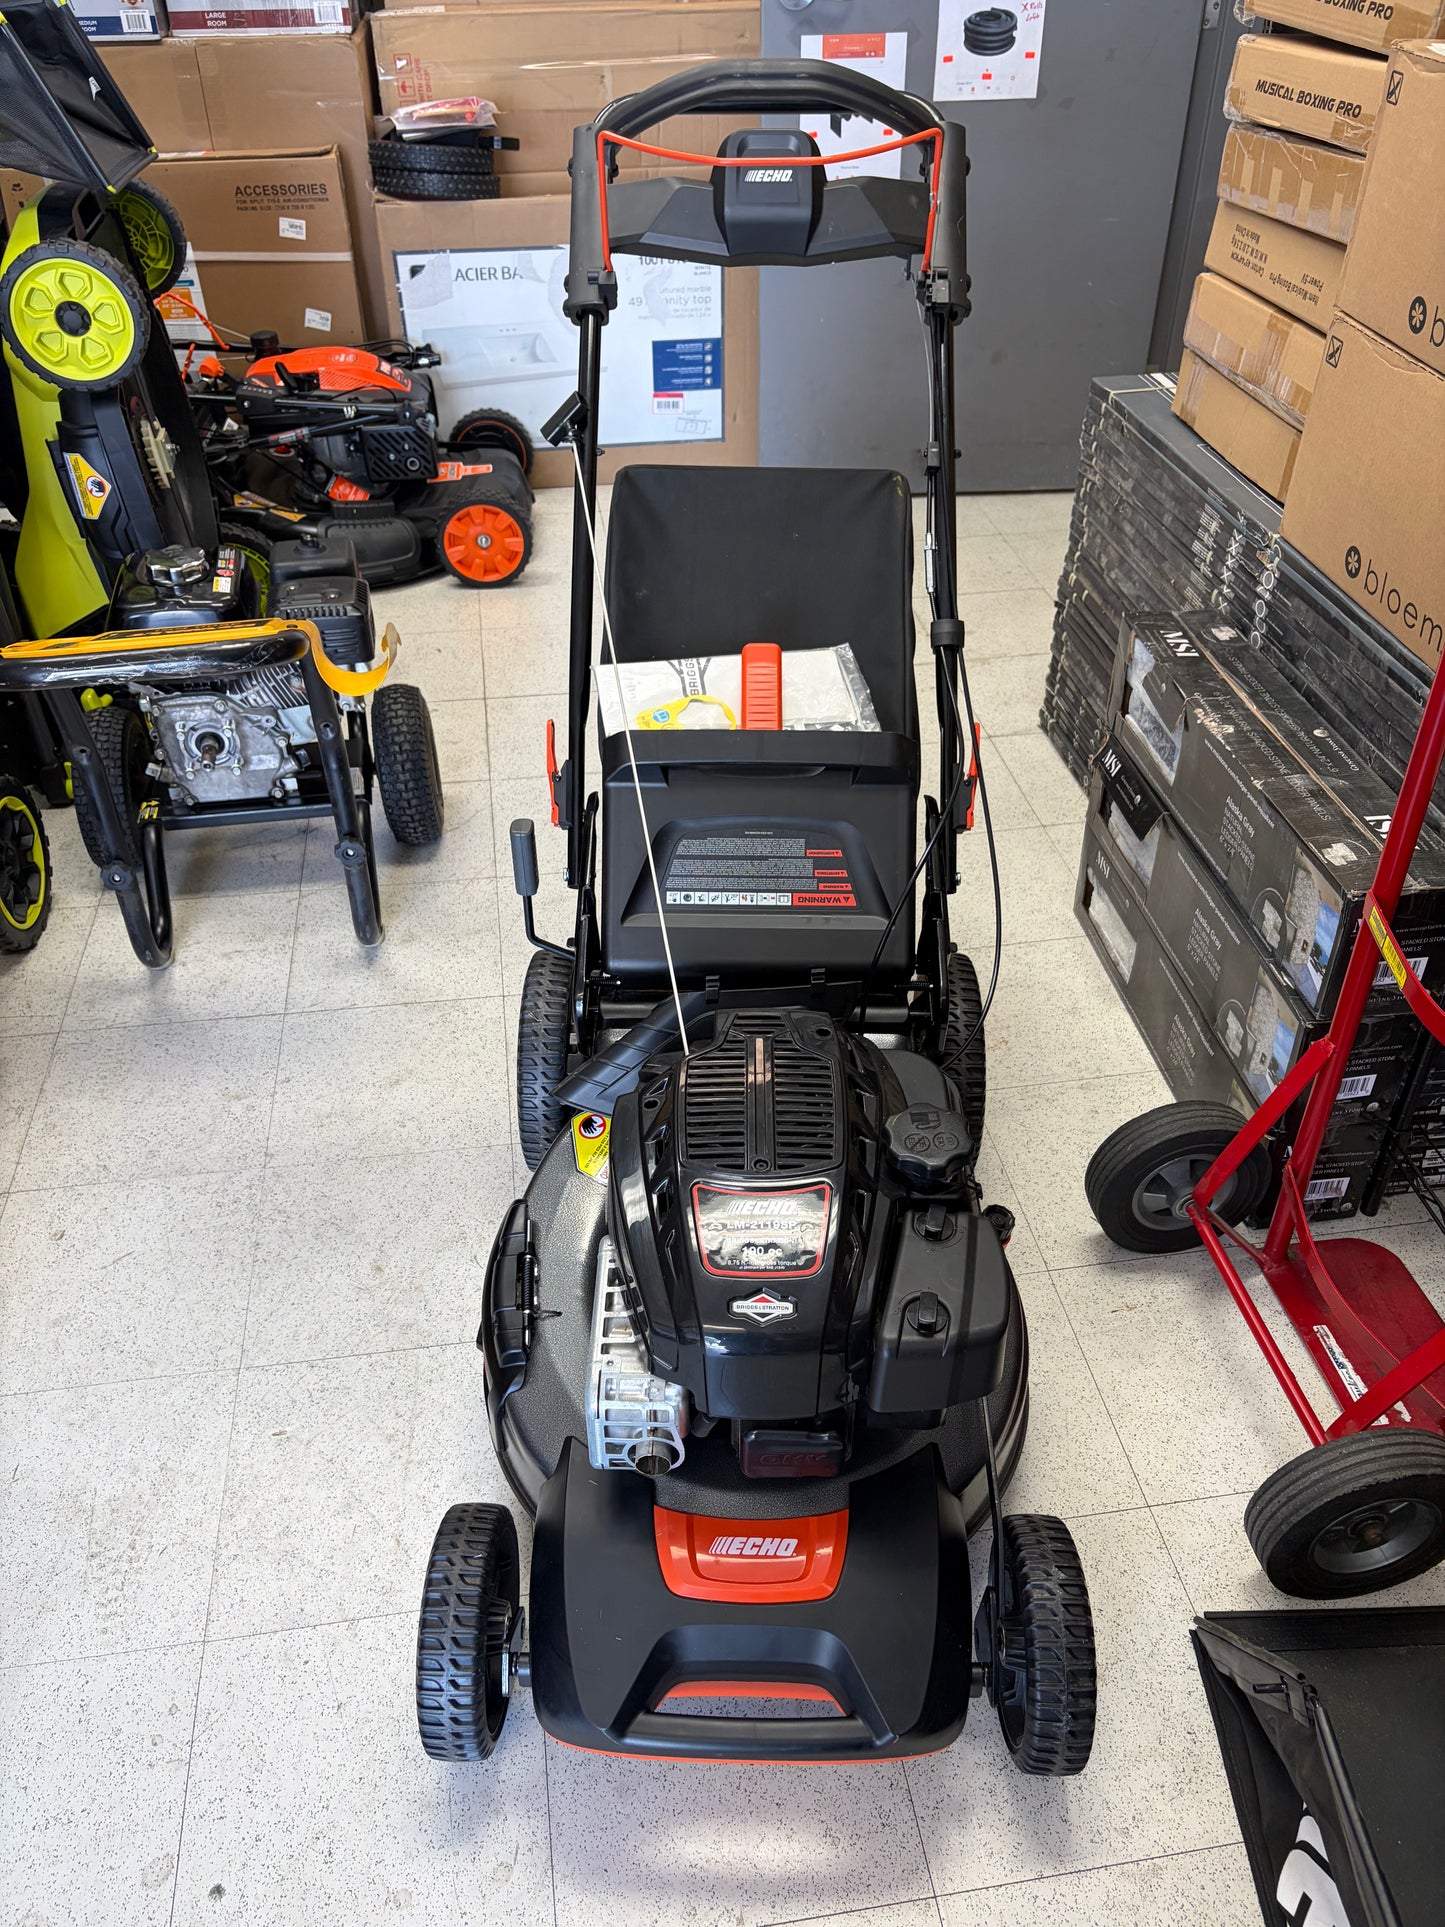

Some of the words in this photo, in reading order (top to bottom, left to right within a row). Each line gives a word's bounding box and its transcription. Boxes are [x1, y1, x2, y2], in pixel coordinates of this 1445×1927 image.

[1366, 3, 1394, 21] PRO
[1255, 79, 1294, 101] MUSICAL
[1296, 90, 1336, 112] BOXING
[1336, 101, 1362, 118] PRO
[749, 170, 792, 182] ECHO
[235, 184, 327, 196] ACCESSORIES
[693, 295, 712, 304] top
[1363, 558, 1444, 653] bloem
[1160, 630, 1200, 657] MSI
[1102, 749, 1122, 777] MSI
[797, 896, 842, 904] WARNING
[735, 1200, 797, 1215] ECHO
[727, 1220, 797, 1230] LM-2119SP
[717, 1537, 798, 1557] ECHO
